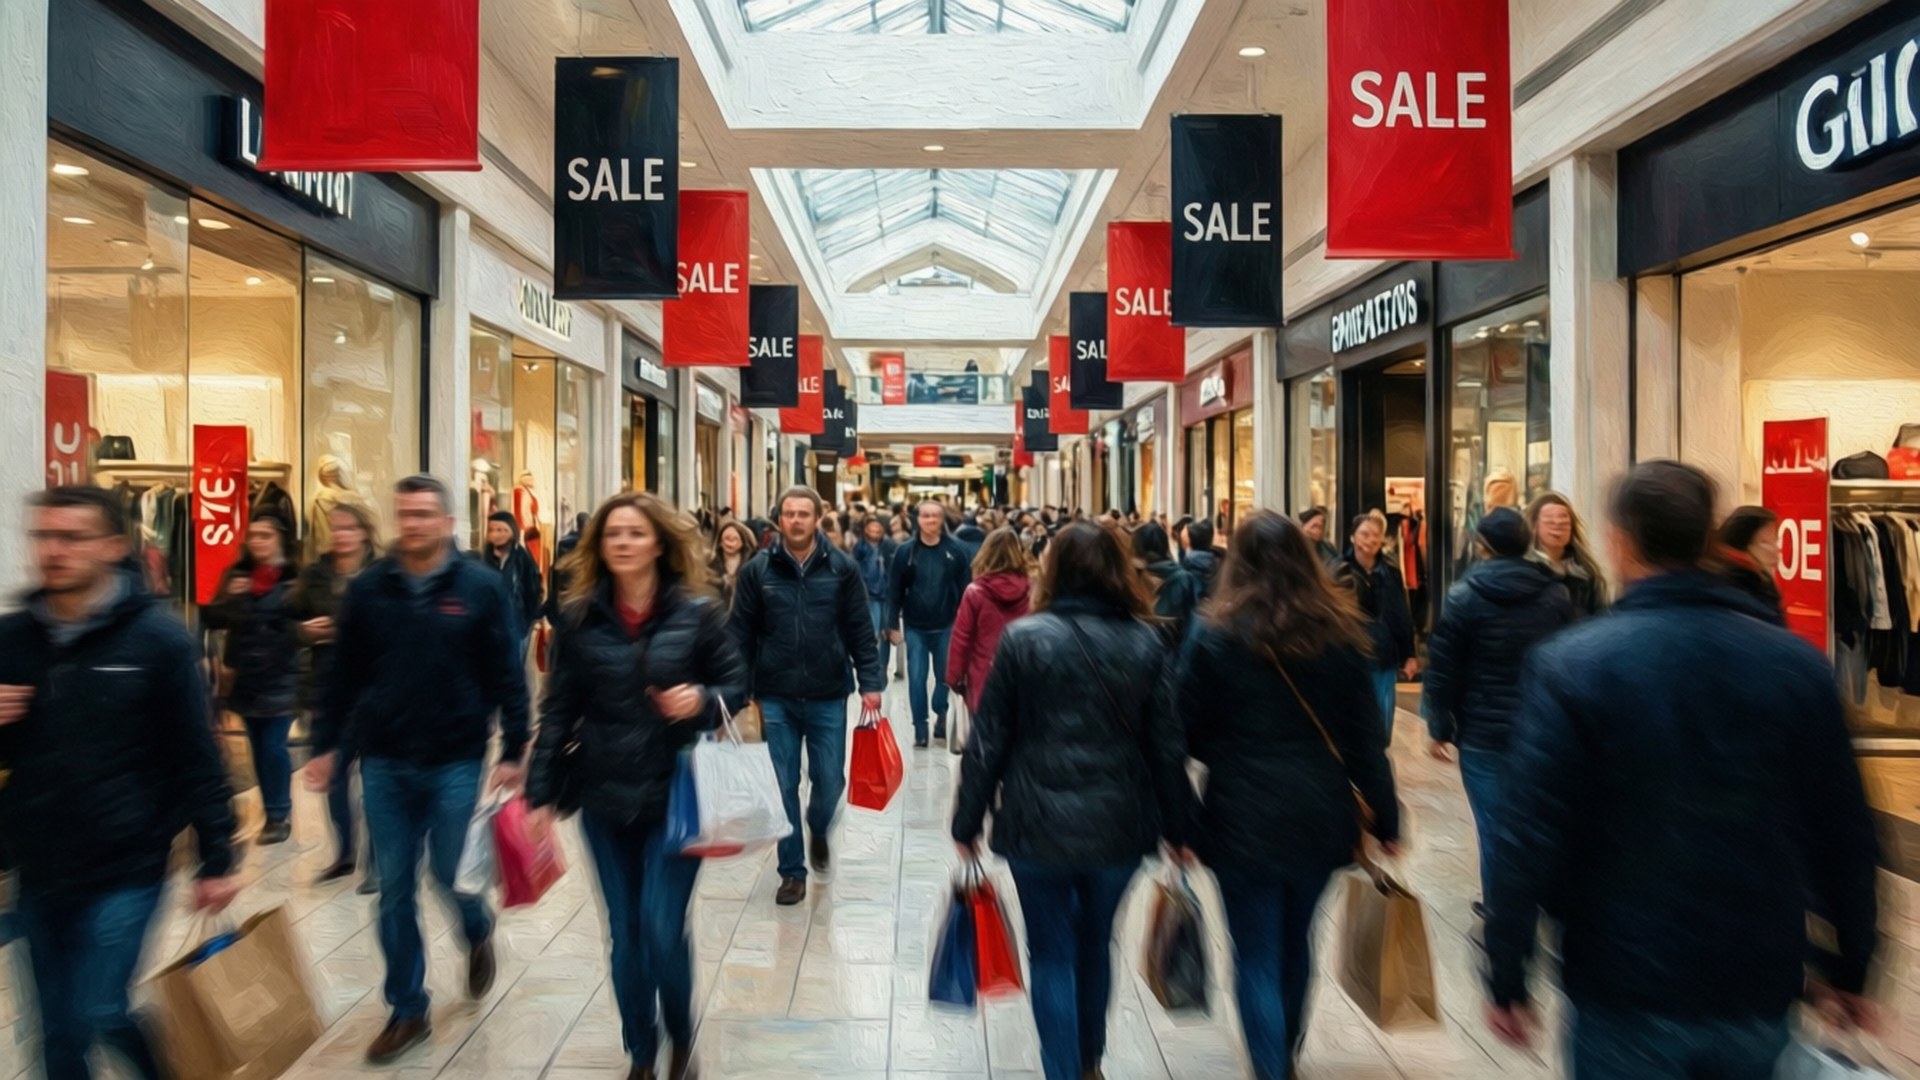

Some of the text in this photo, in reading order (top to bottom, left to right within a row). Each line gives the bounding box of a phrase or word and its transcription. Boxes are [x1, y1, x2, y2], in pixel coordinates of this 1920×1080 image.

[1351, 70, 1487, 129] SALE
[567, 157, 665, 202] SALE
[1183, 201, 1272, 242] SALE
[677, 262, 740, 295] SALE
[749, 336, 794, 359] SALE
[1076, 339, 1107, 361] SAL
[799, 376, 820, 394] LE
